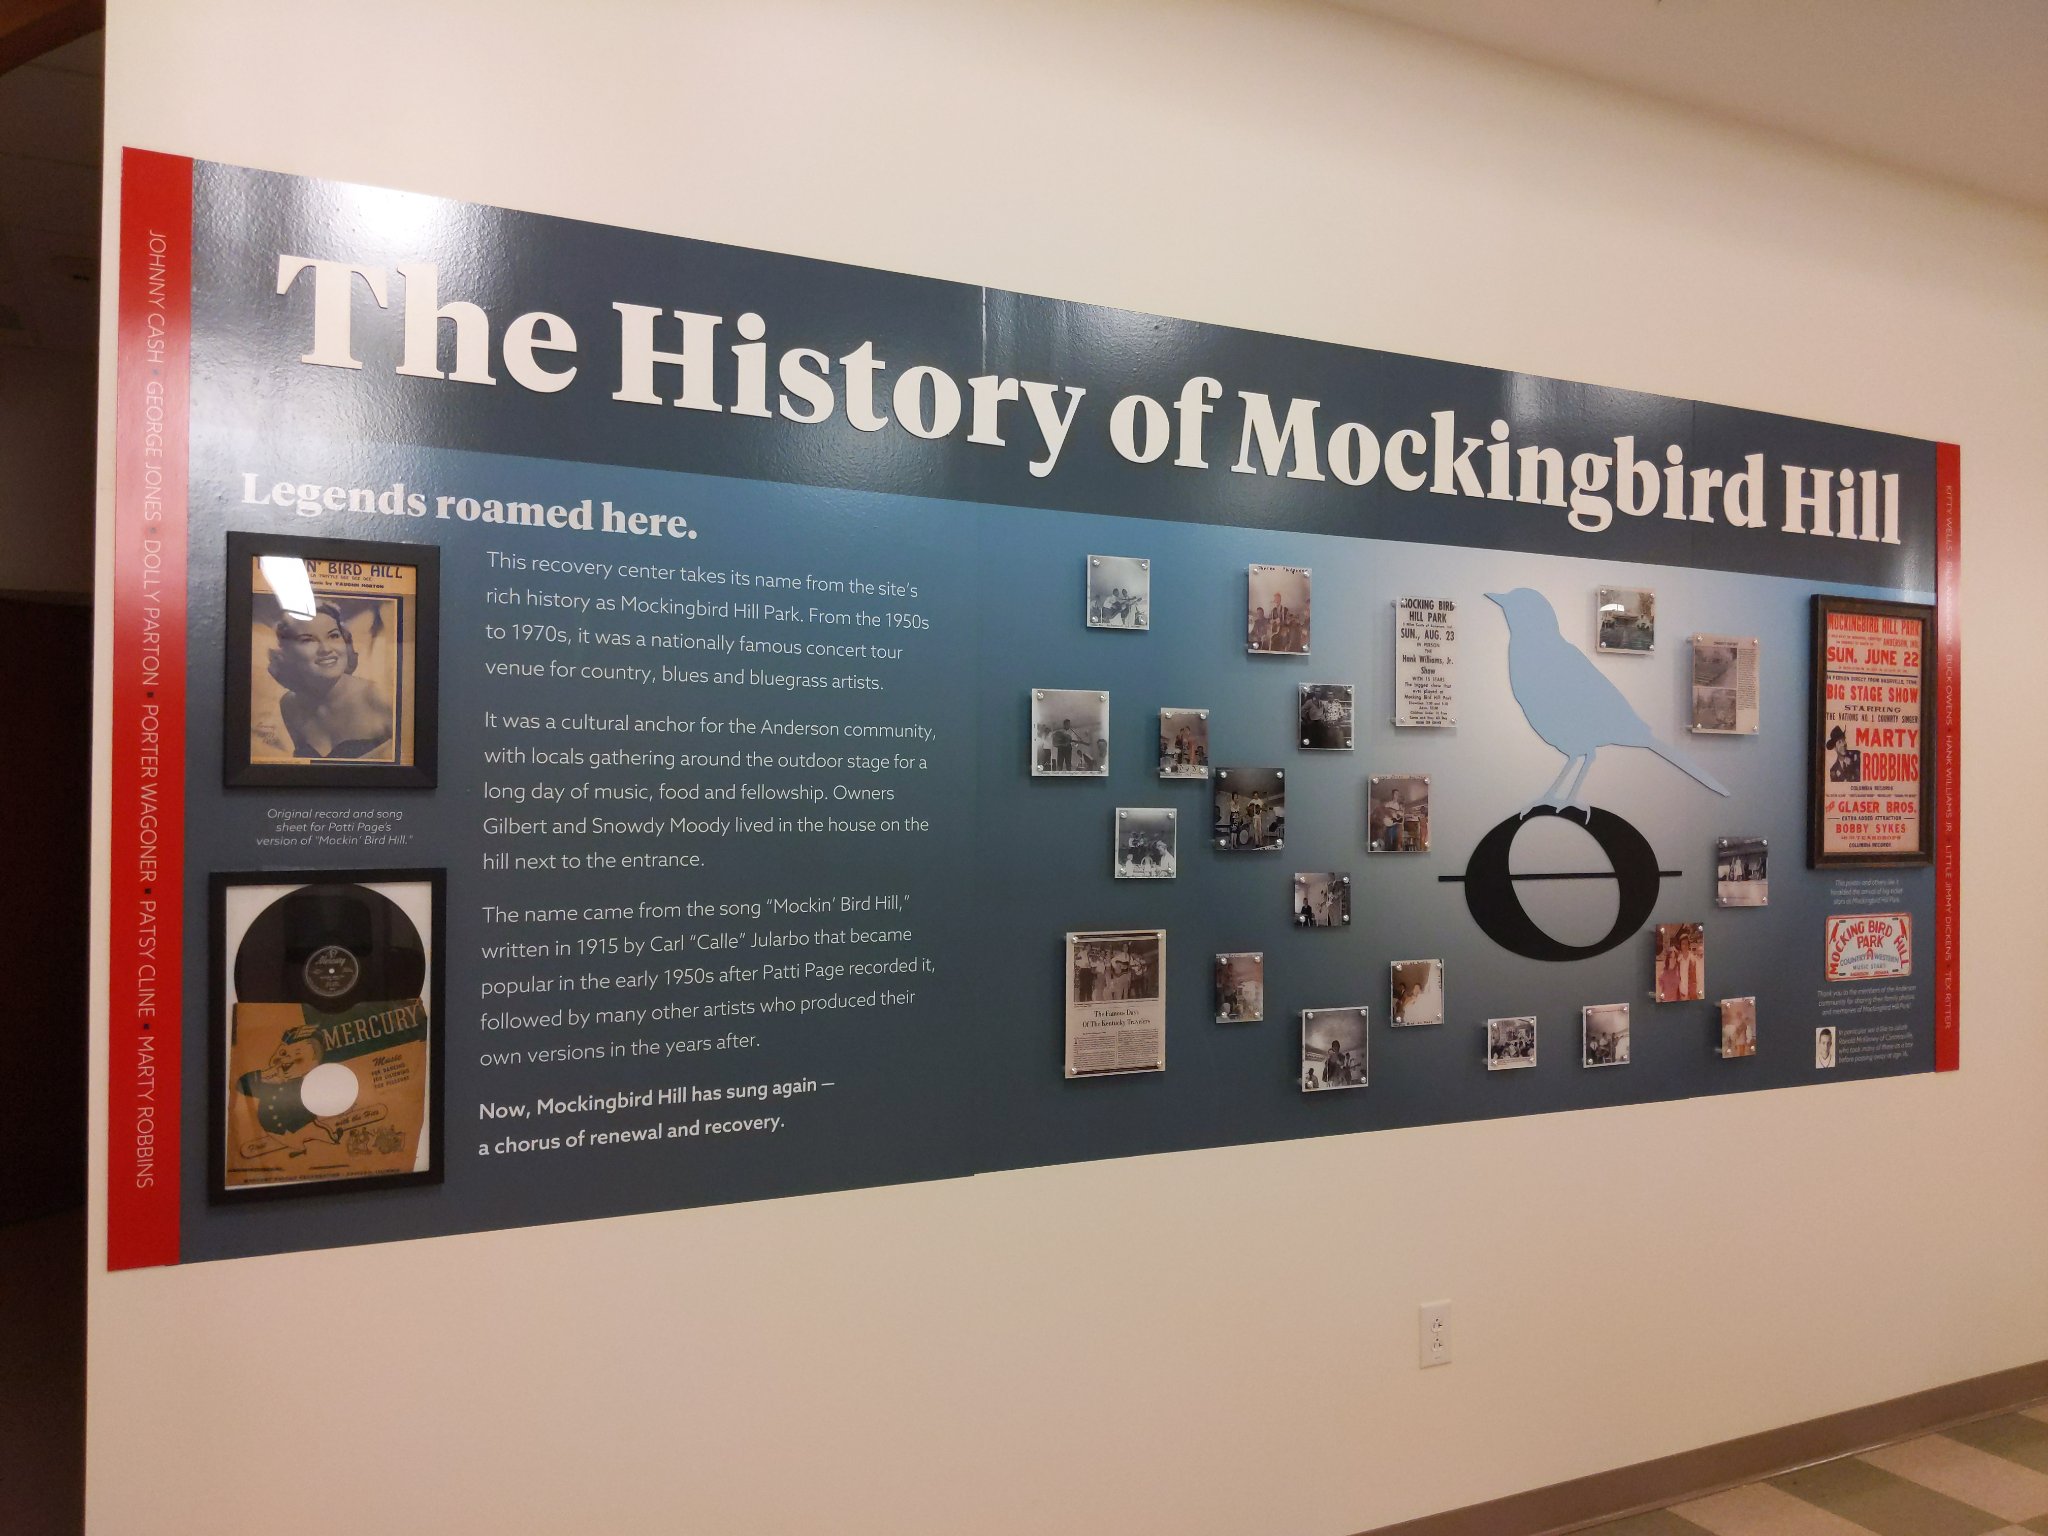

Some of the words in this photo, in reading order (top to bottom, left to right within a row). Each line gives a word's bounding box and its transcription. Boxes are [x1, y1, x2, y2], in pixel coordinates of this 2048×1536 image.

[148, 230, 167, 309] JOHNNY
[147, 313, 166, 363] CASH
[276, 254, 578, 393] The
[612, 301, 1087, 478] History
[1109, 375, 1224, 469] of
[1231, 391, 1767, 533] Mockingbird
[1780, 464, 1901, 545] Hill
[145, 381, 164, 457] GEORGE
[144, 462, 162, 521] JONES
[243, 471, 427, 518] Legends
[435, 494, 594, 531] roamed
[601, 502, 698, 540] here.
[1945, 485, 1953, 514] KITTY
[143, 539, 161, 602] DOLLY
[328, 561, 362, 576] BIRD
[370, 564, 403, 579] HILL
[486, 587, 521, 605] rich
[526, 588, 591, 614] history
[595, 597, 616, 611] as
[621, 595, 729, 620] Mockingbird
[734, 602, 759, 620] Hill
[764, 604, 804, 623] Park.
[809, 607, 851, 625] From
[855, 609, 881, 627] the
[885, 612, 930, 630] 1950s
[1409, 611, 1424, 622] HILL
[1427, 612, 1447, 623] PARK
[1828, 614, 1879, 633] MOCKINGBIRD
[1882, 618, 1899, 635] HILL
[1901, 620, 1919, 636] PARK
[142, 607, 160, 686] PARTON
[484, 623, 506, 640] to
[511, 623, 572, 646] 1970s,
[578, 627, 591, 644] it
[594, 632, 631, 646] was
[635, 634, 647, 647] a
[651, 633, 735, 655] nationally
[738, 635, 802, 655] famous
[806, 643, 867, 658] concert
[870, 644, 904, 660] tour
[1424, 629, 1442, 641] AUG.
[1445, 630, 1455, 641] 23
[1402, 655, 1417, 663] Hank
[1420, 666, 1436, 675] Show
[1827, 646, 1858, 664] SUN.
[1864, 649, 1897, 666] JUNE
[1903, 652, 1919, 667] 22
[1945, 653, 1953, 683] BUCK
[484, 662, 545, 677] venue
[549, 659, 577, 678] for
[580, 665, 656, 685] country,
[662, 664, 709, 684] blues
[713, 668, 745, 685] and
[749, 668, 828, 691] bluegrass
[831, 674, 884, 691] artists.
[1826, 683, 1845, 700] BIG
[1850, 685, 1883, 702] STAGE
[1888, 687, 1918, 704] SHOW
[1844, 705, 1901, 713] STARRING
[1945, 685, 1953, 726] OWENS
[140, 704, 159, 778] PORTER
[485, 710, 498, 728] It
[501, 716, 541, 729] was
[545, 717, 557, 730] a
[561, 713, 629, 731] cultural
[634, 715, 696, 733] anchor
[699, 716, 725, 734] for
[728, 717, 757, 735] the
[760, 718, 840, 737] Anderson
[843, 723, 936, 743] community,
[1855, 727, 1919, 748] MARTY
[1945, 735, 1953, 763] HANK
[1862, 752, 1919, 782] ROBBINS
[1838, 801, 1880, 813] GLASER
[1886, 801, 1917, 813] BROS.
[1945, 767, 1953, 818] WILLIAMS
[267, 808, 312, 821] Original
[314, 808, 351, 819] record
[352, 808, 375, 819] and
[376, 810, 403, 821] song
[275, 822, 307, 832] sheet
[310, 822, 326, 832] for
[328, 822, 355, 831] Patti
[1836, 823, 1869, 834] BOBBY
[1875, 823, 1906, 834] SYKES
[139, 782, 158, 882] WAGONER
[256, 836, 298, 846] version
[300, 835, 313, 846] of
[364, 835, 386, 845] Bird
[483, 852, 509, 870] hill
[514, 854, 557, 870] next
[560, 854, 581, 869] to
[585, 851, 617, 869] the
[621, 853, 705, 868] entrance.
[1944, 845, 1952, 878] LITTLE
[1944, 881, 1952, 912] JIMMY
[138, 900, 157, 960] PATSY
[1857, 934, 1885, 949] PARK
[1944, 916, 1952, 961] DICKENS
[1829, 921, 1865, 975] MOCKING
[1868, 920, 1893, 938] BIRD
[1893, 935, 1909, 969] HILL
[137, 964, 156, 1018] CLINE
[481, 975, 555, 1000] popular
[559, 975, 575, 991] in
[579, 972, 611, 990] the
[615, 969, 659, 991] early
[663, 967, 715, 986] 1950s
[718, 965, 759, 983] after
[763, 963, 800, 981] Patti
[804, 962, 845, 981] Page
[849, 956, 918, 976] recorded
[921, 957, 935, 974] it,
[1944, 971, 1952, 992] TEX
[322, 1005, 419, 1051] MERCURY
[1944, 993, 1952, 1030] RITTER
[137, 1036, 155, 1102] MARTY
[479, 1102, 531, 1121] Now,
[537, 1088, 653, 1116] Mockingbird
[658, 1086, 687, 1105] Hill
[691, 1085, 722, 1103] has
[726, 1084, 768, 1101] sung
[772, 1076, 817, 1099] again
[136, 1107, 155, 1189] ROBBINS
[478, 1143, 491, 1156] a
[494, 1135, 561, 1155] chorus
[565, 1129, 586, 1148] of
[590, 1122, 663, 1146] renewal
[666, 1118, 700, 1139] and
[704, 1116, 785, 1135] recovery.
